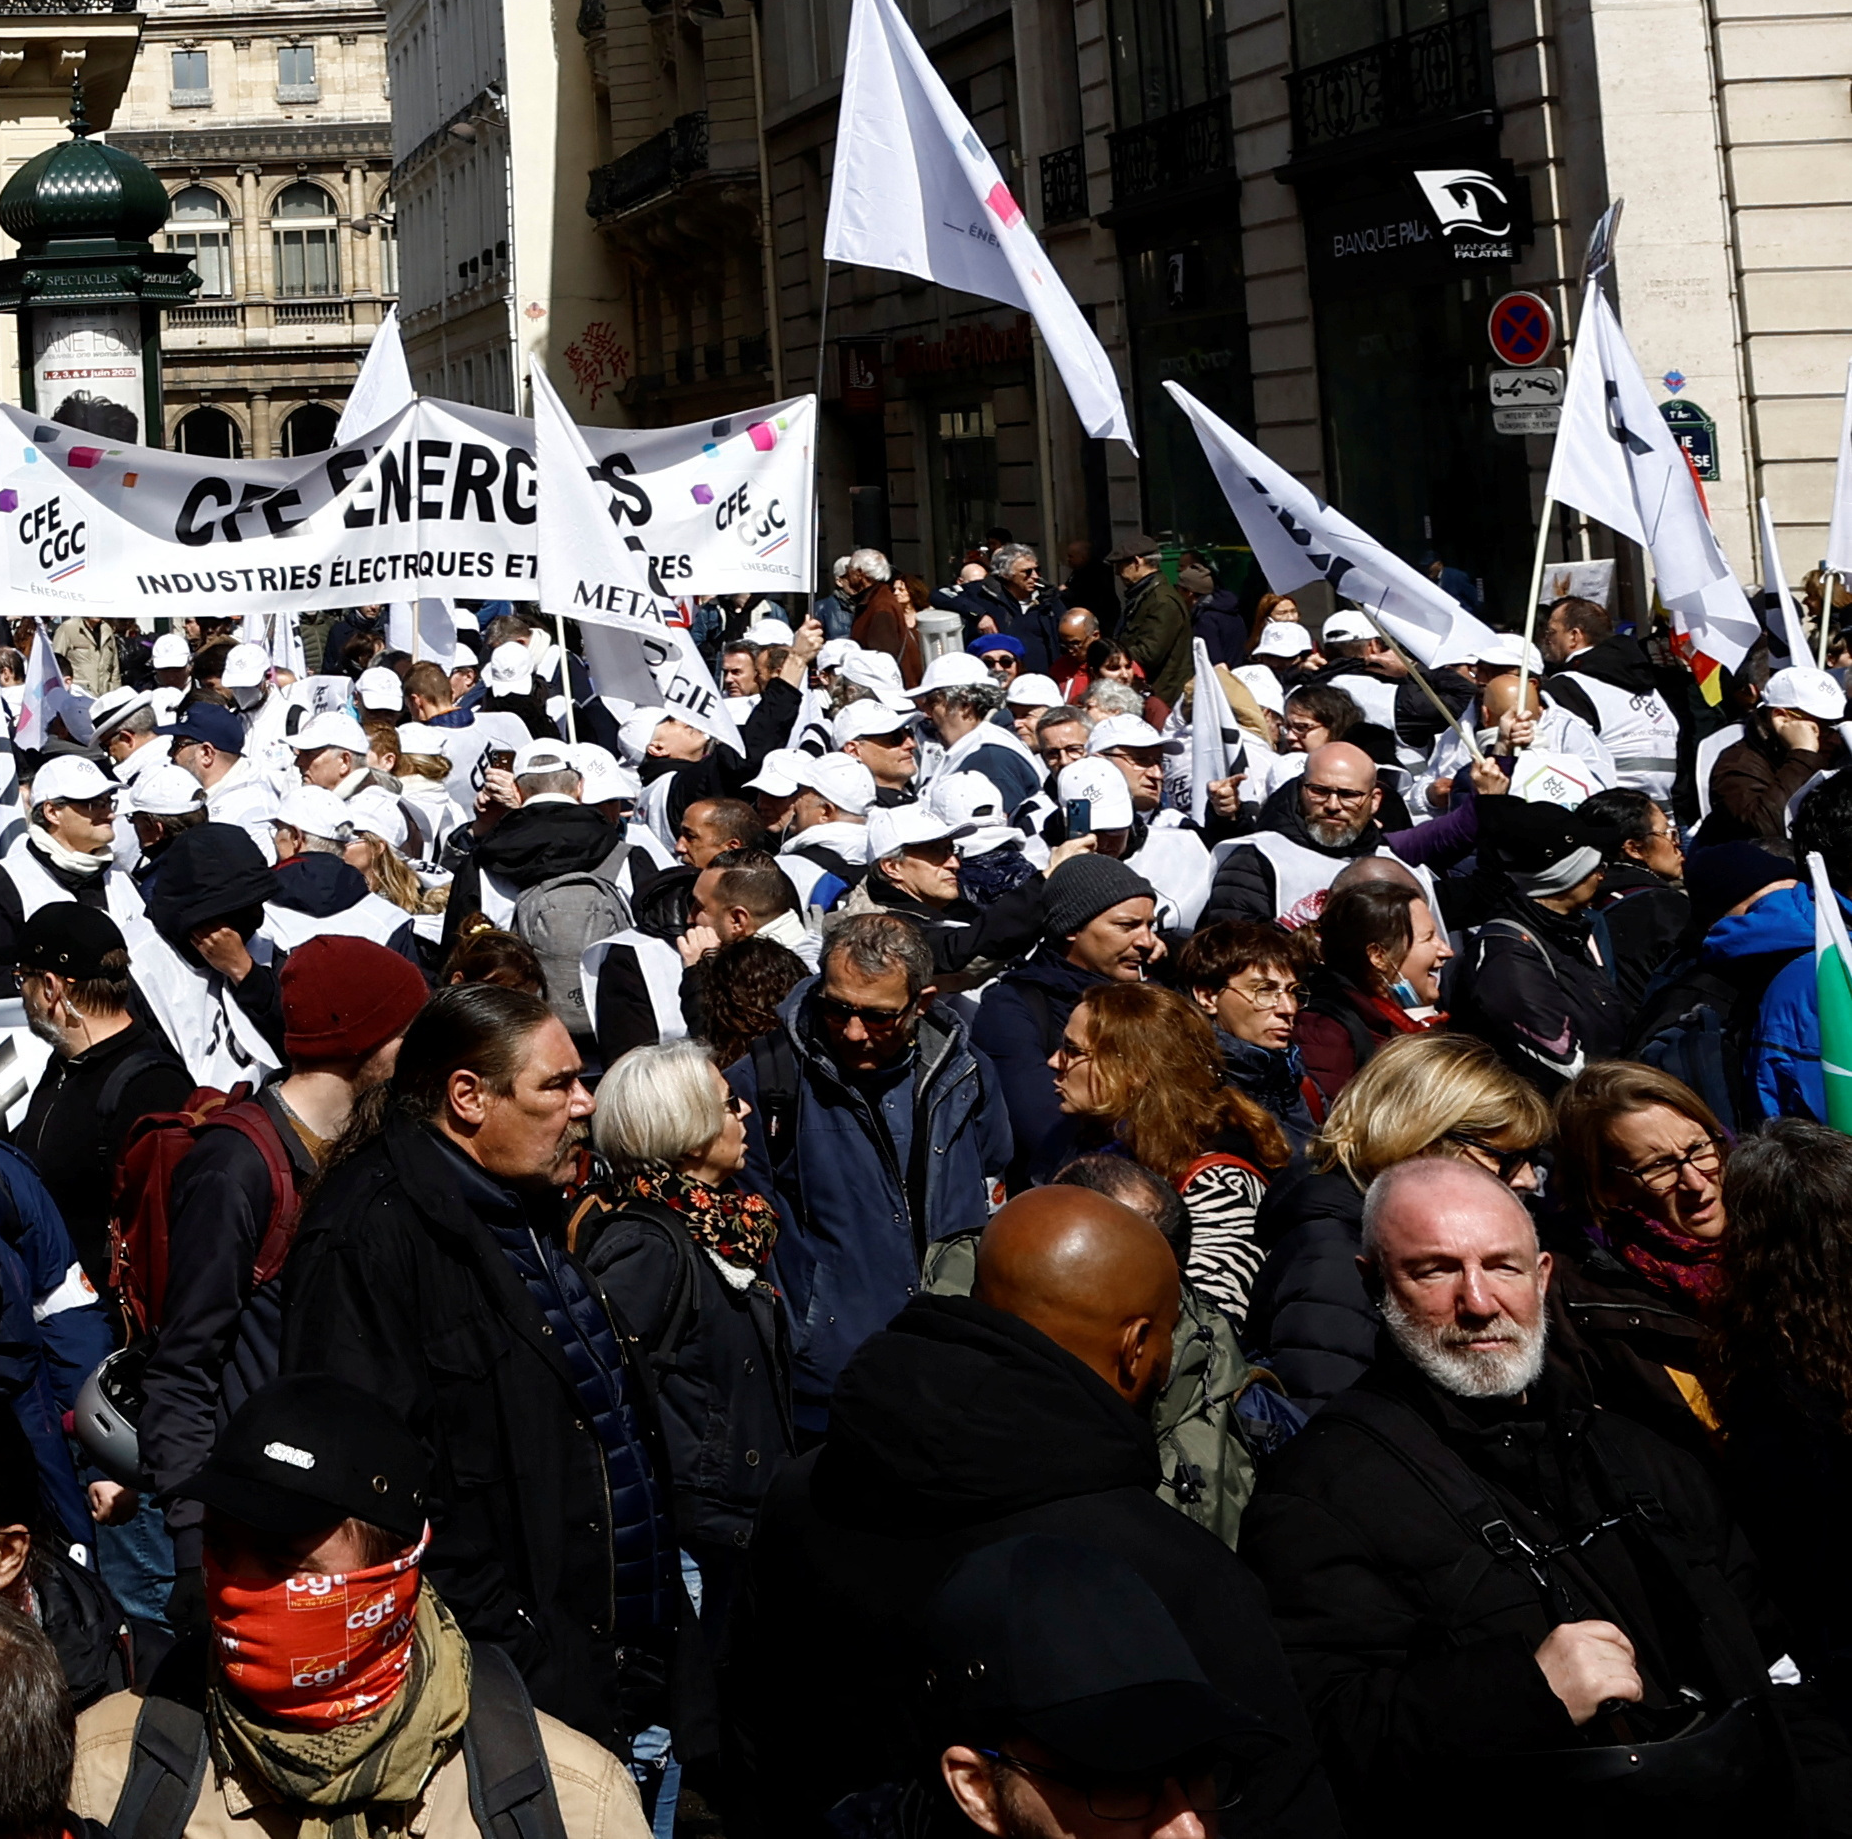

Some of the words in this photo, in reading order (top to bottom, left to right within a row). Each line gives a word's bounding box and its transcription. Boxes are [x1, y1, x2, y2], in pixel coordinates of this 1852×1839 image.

[1398, 220, 1434, 245] PALA
[1453, 249, 1514, 259] PALATINE
[47, 272, 118, 287] SPECTACLES
[92, 327, 142, 353] FOLY
[91, 369, 111, 378] juin
[111, 368, 135, 377] 2023
[18, 495, 61, 545] CFE
[175, 477, 310, 547] CFE
[715, 481, 751, 532] CFE
[736, 498, 786, 548] CGC
[38, 521, 86, 570] CGC
[30, 582, 86, 603] ÉNERGIES
[137, 563, 323, 595] INDUSTRIES
[573, 579, 662, 622] META
[346, 1592, 396, 1629] cgt
[293, 1659, 348, 1687] cgt
